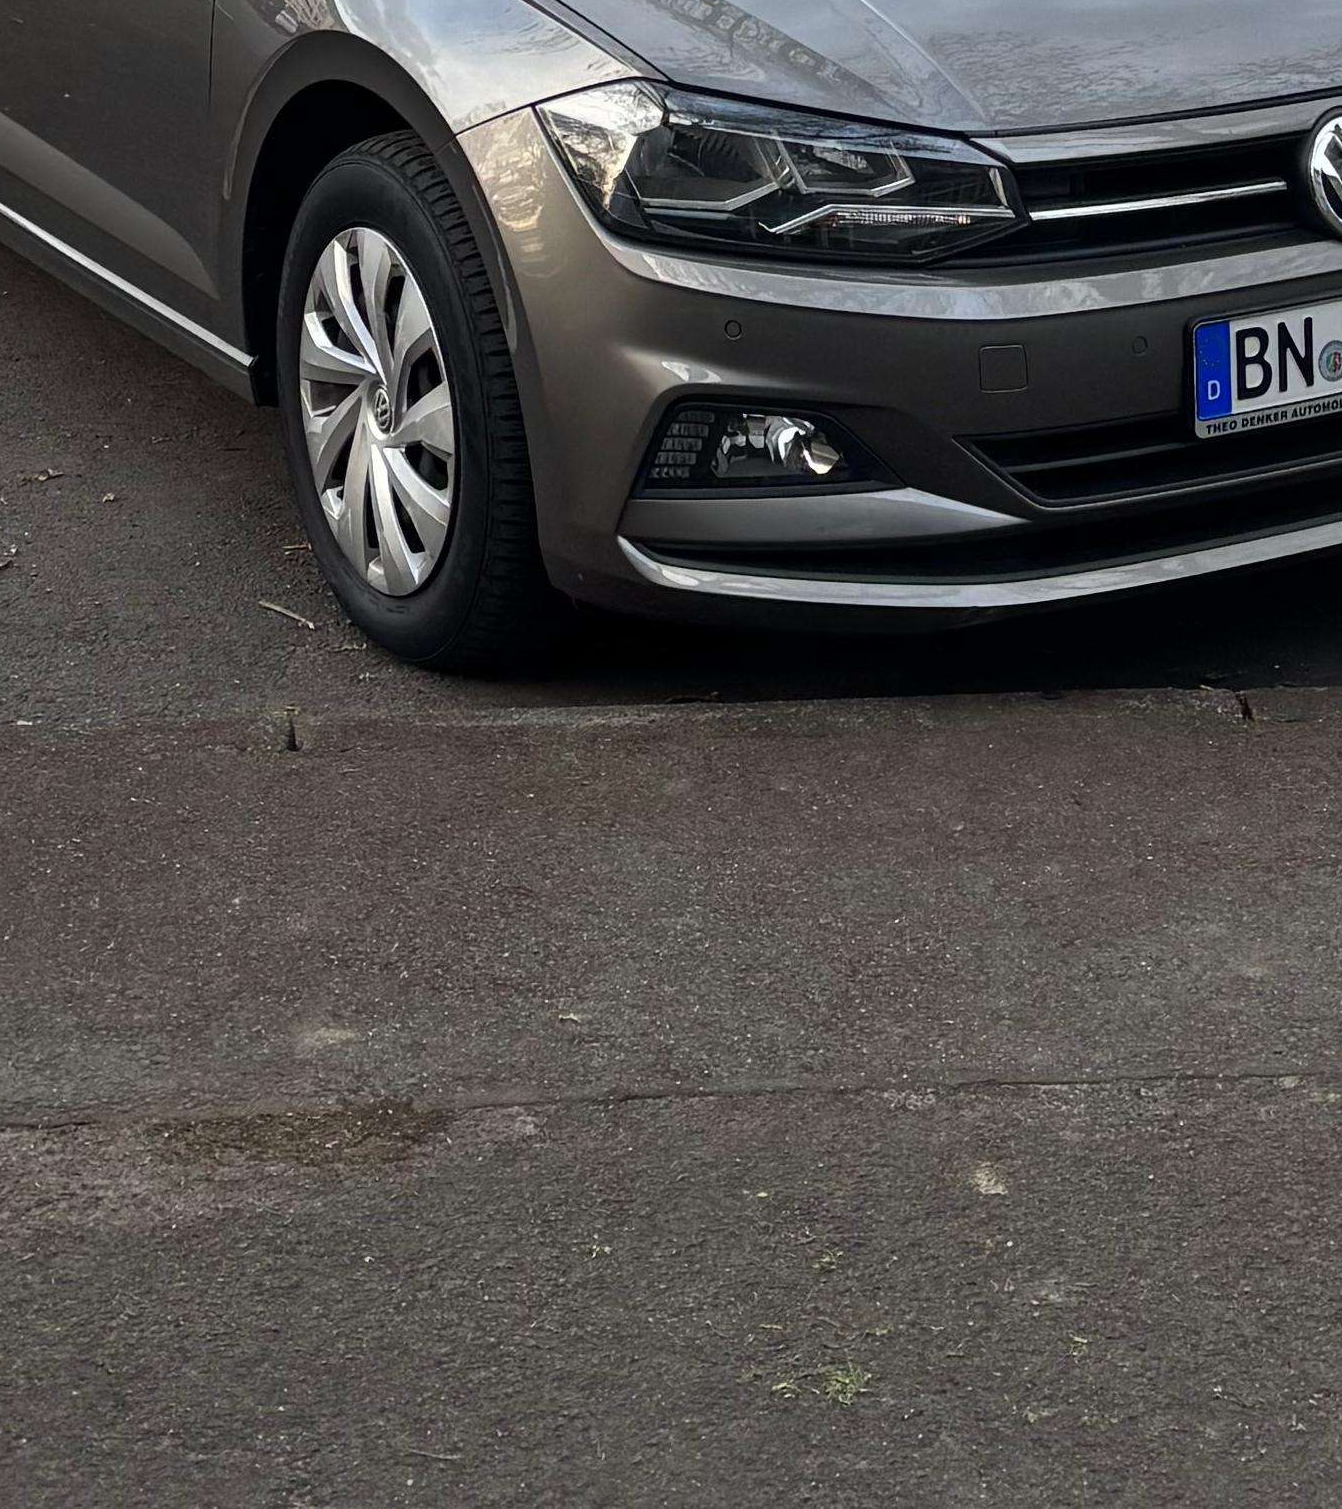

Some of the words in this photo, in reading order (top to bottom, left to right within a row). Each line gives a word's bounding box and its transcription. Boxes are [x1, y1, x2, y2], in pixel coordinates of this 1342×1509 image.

[1235, 316, 1315, 401] BN
[1207, 380, 1221, 400] D
[1205, 419, 1238, 435] THEO
